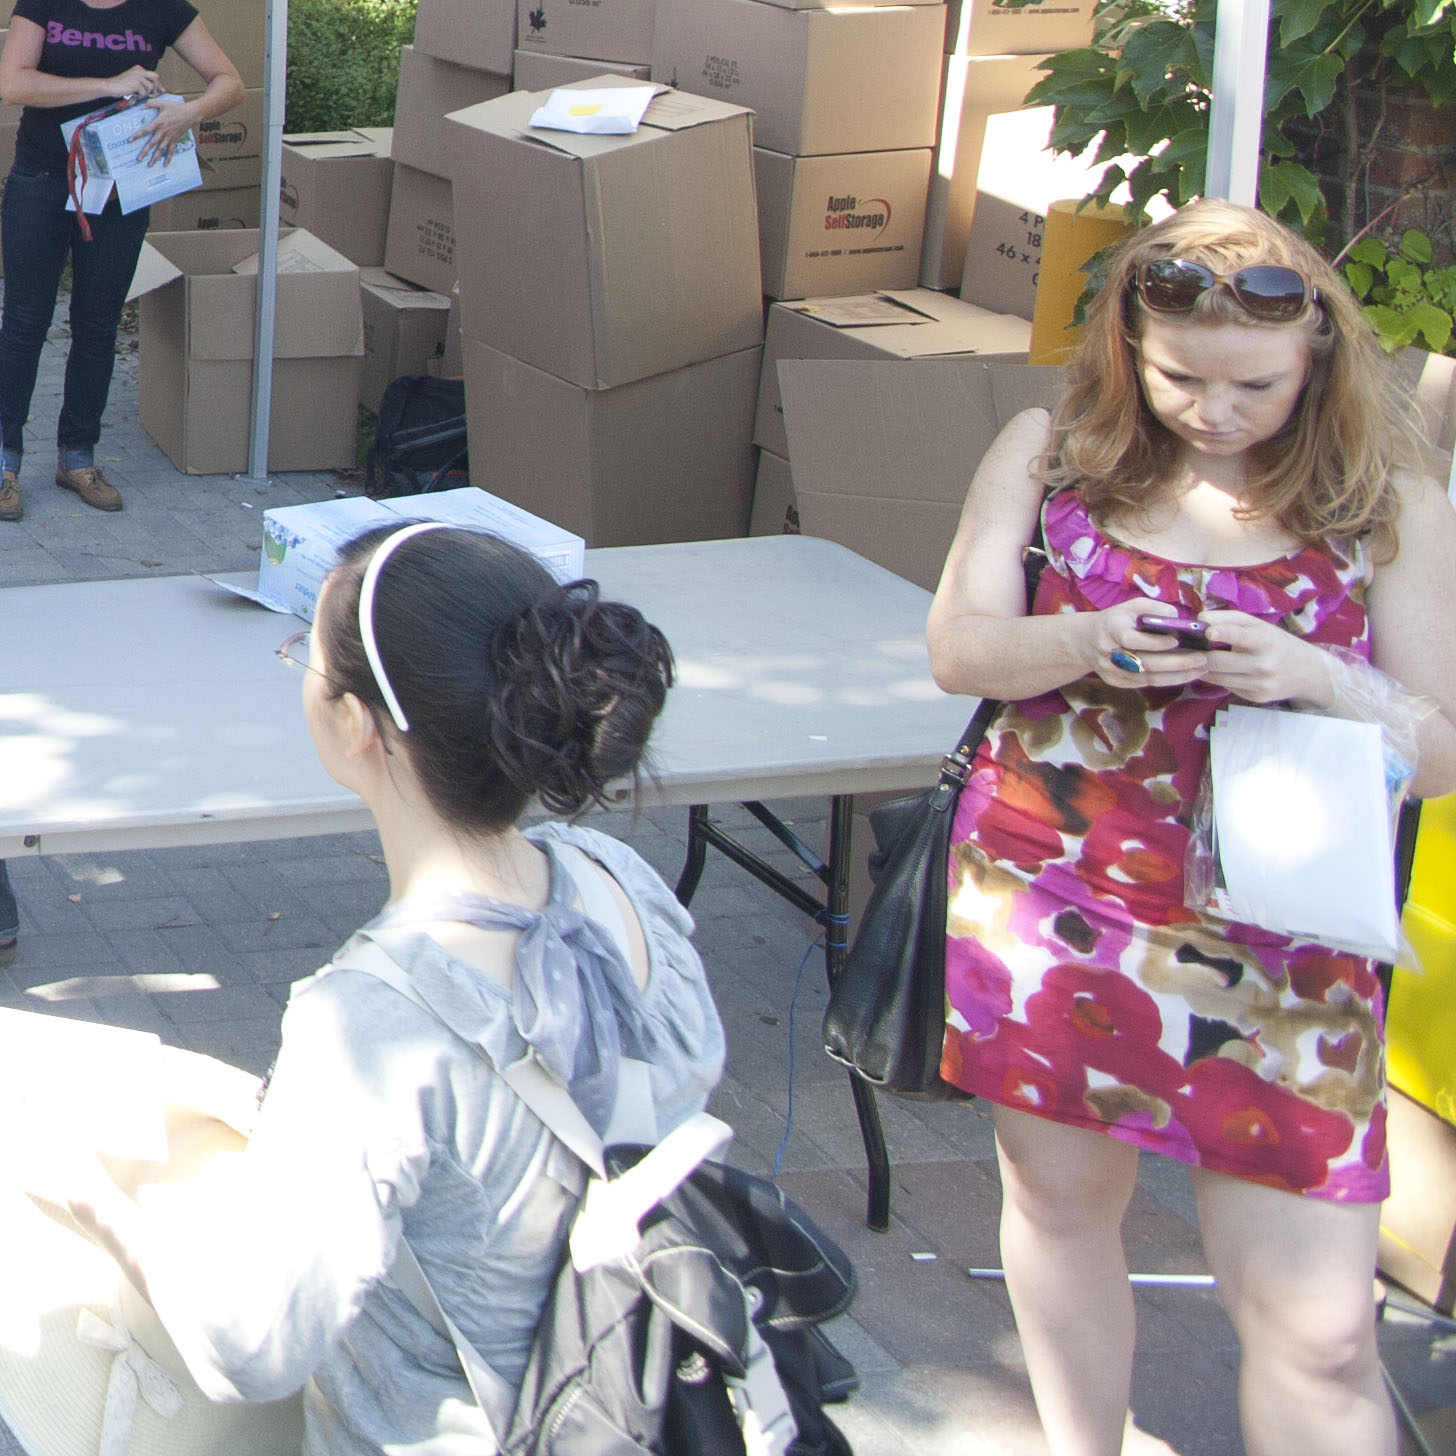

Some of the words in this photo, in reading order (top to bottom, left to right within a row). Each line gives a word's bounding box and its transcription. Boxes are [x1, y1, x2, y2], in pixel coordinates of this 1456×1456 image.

[46, 20, 153, 52] Bench.
[199, 120, 220, 132] Apple
[199, 131, 243, 144] SelfStorage
[827, 195, 856, 213] Apple
[825, 213, 884, 230] SelfStorage
[1019, 212, 1029, 224] 4
[1027, 232, 1042, 247] 18
[996, 243, 1016, 259] 46
[1020, 253, 1030, 264] x
